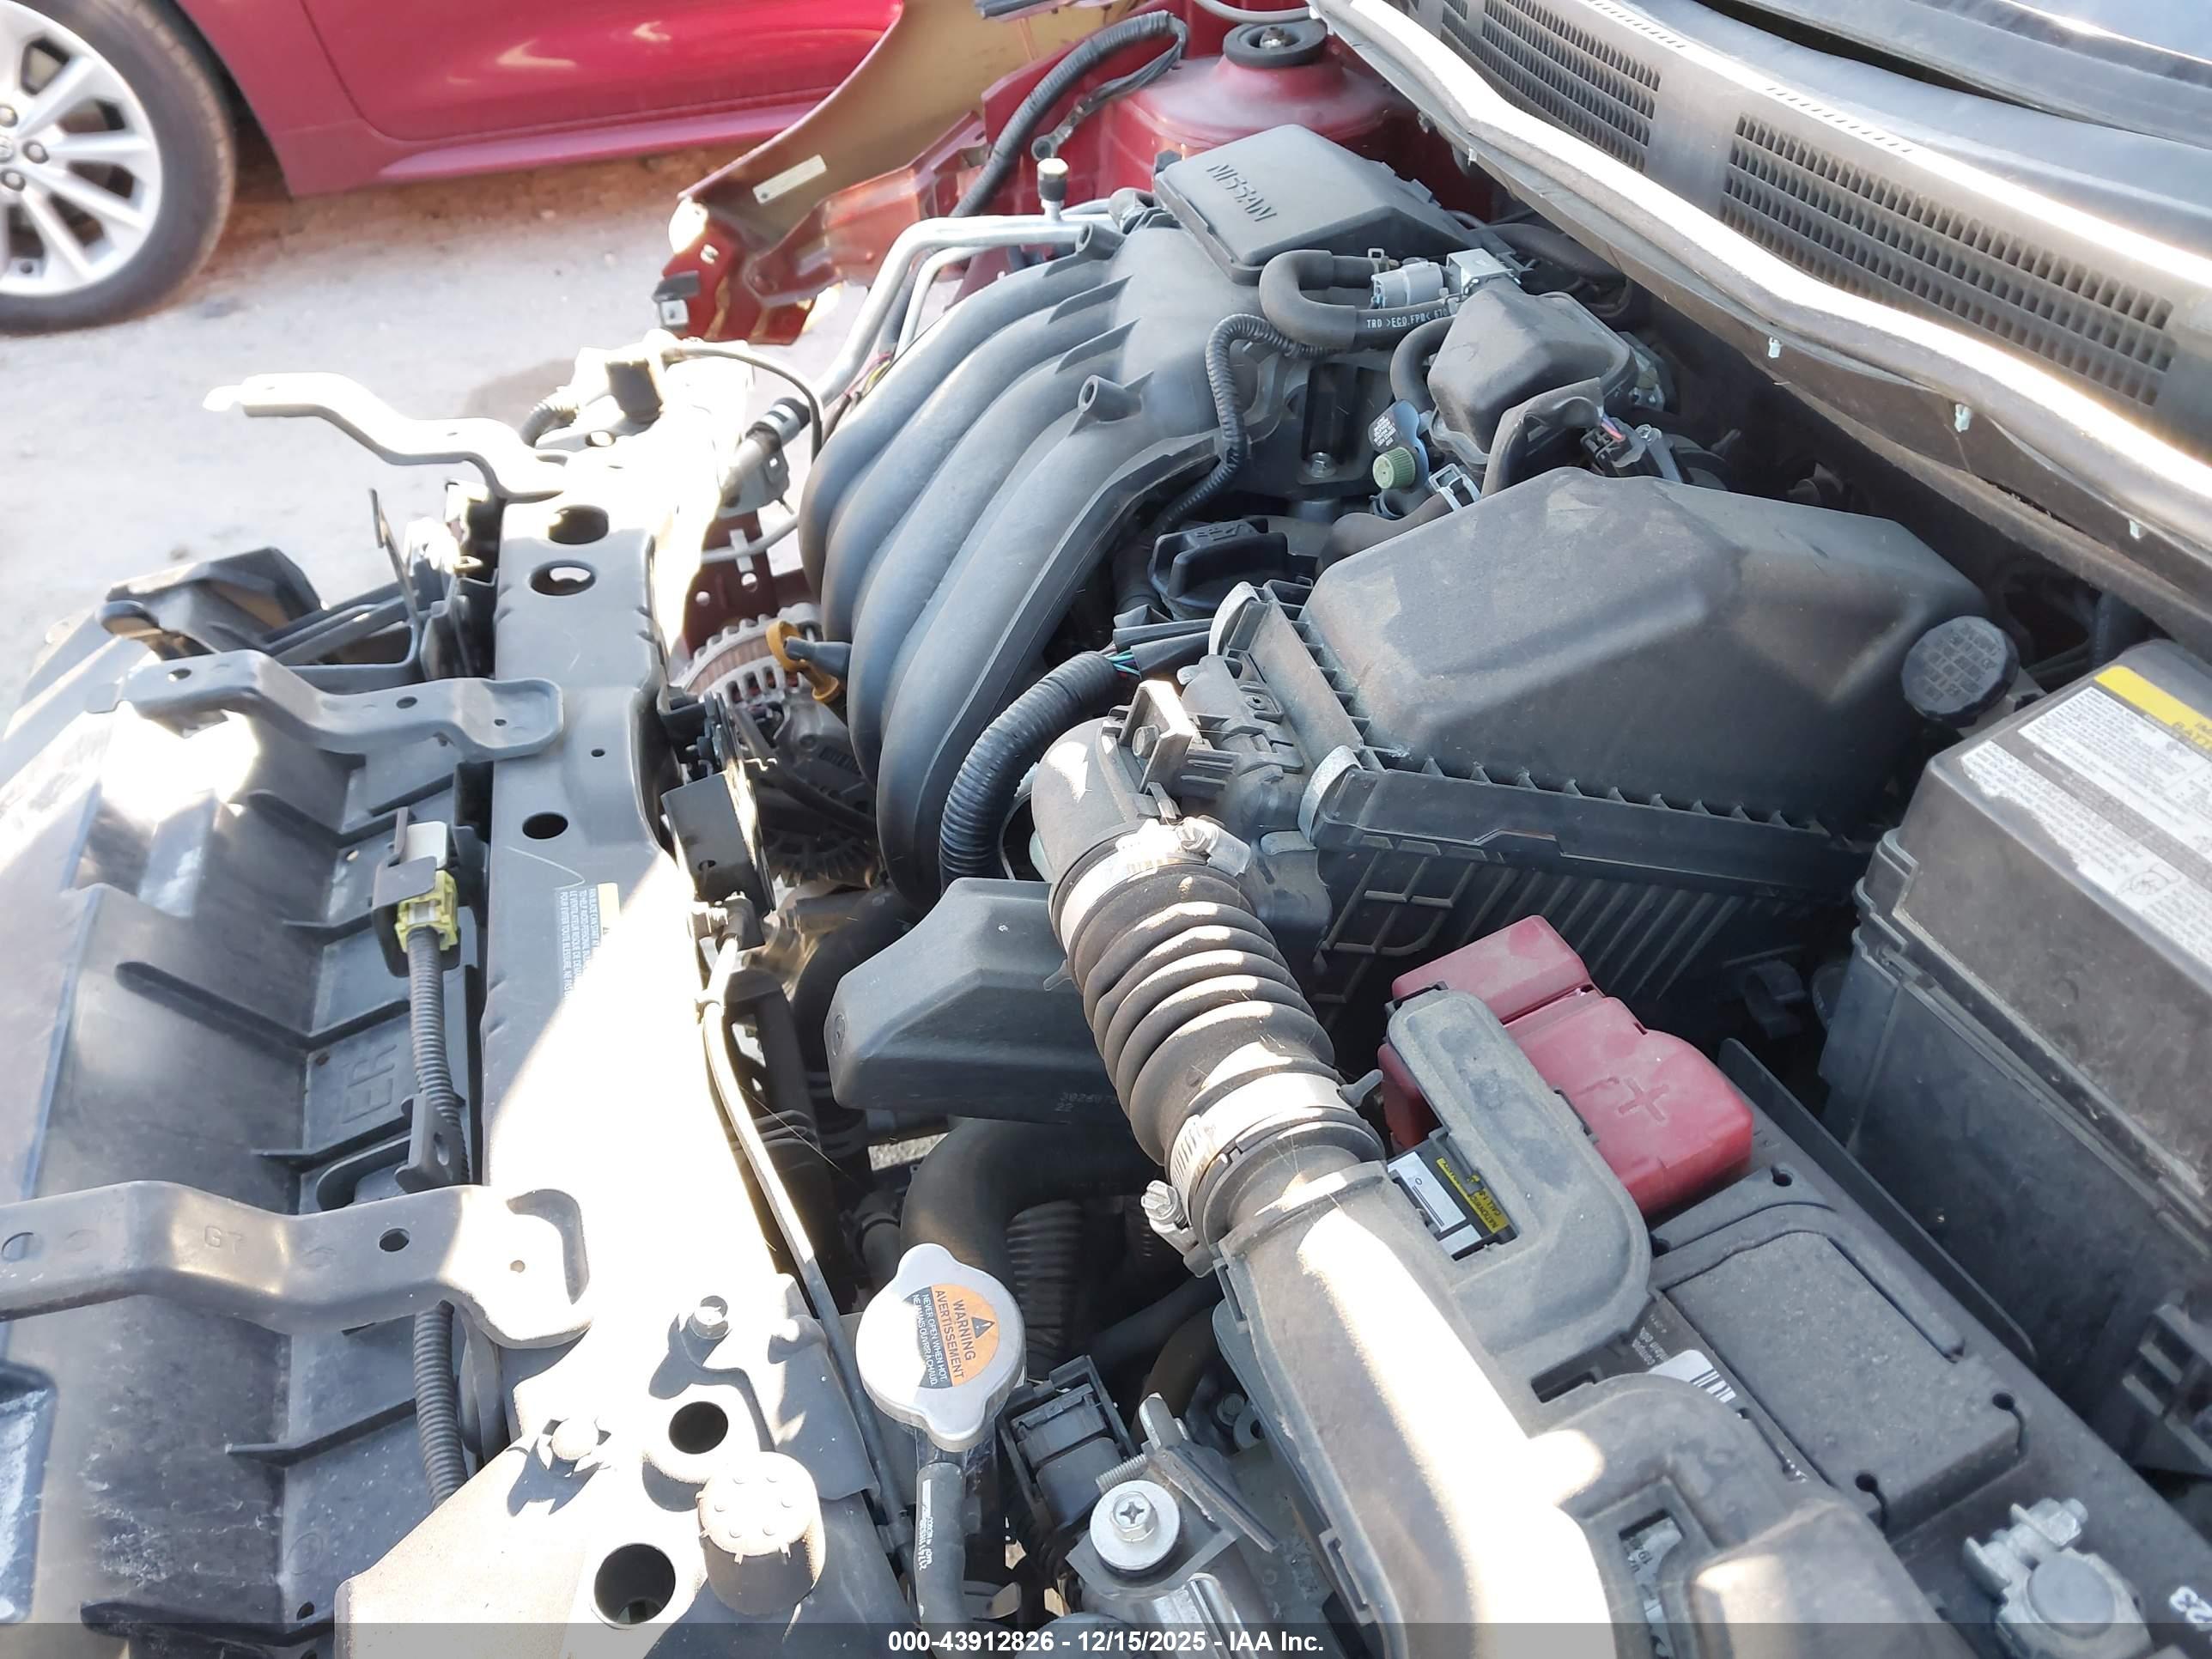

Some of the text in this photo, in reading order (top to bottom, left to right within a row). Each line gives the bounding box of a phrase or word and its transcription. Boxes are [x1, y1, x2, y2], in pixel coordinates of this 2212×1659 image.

[1206, 164, 1278, 222] NISSAN
[1468, 1194, 1498, 1229] NATIONWID
[912, 1294, 920, 1304] NE
[921, 1294, 933, 1317] NEVER
[927, 1318, 938, 1339] OPEN
[935, 1290, 964, 1378] AVERTISSEMENT
[952, 1299, 976, 1361] WARNING
[932, 1340, 943, 1364] WHEN
